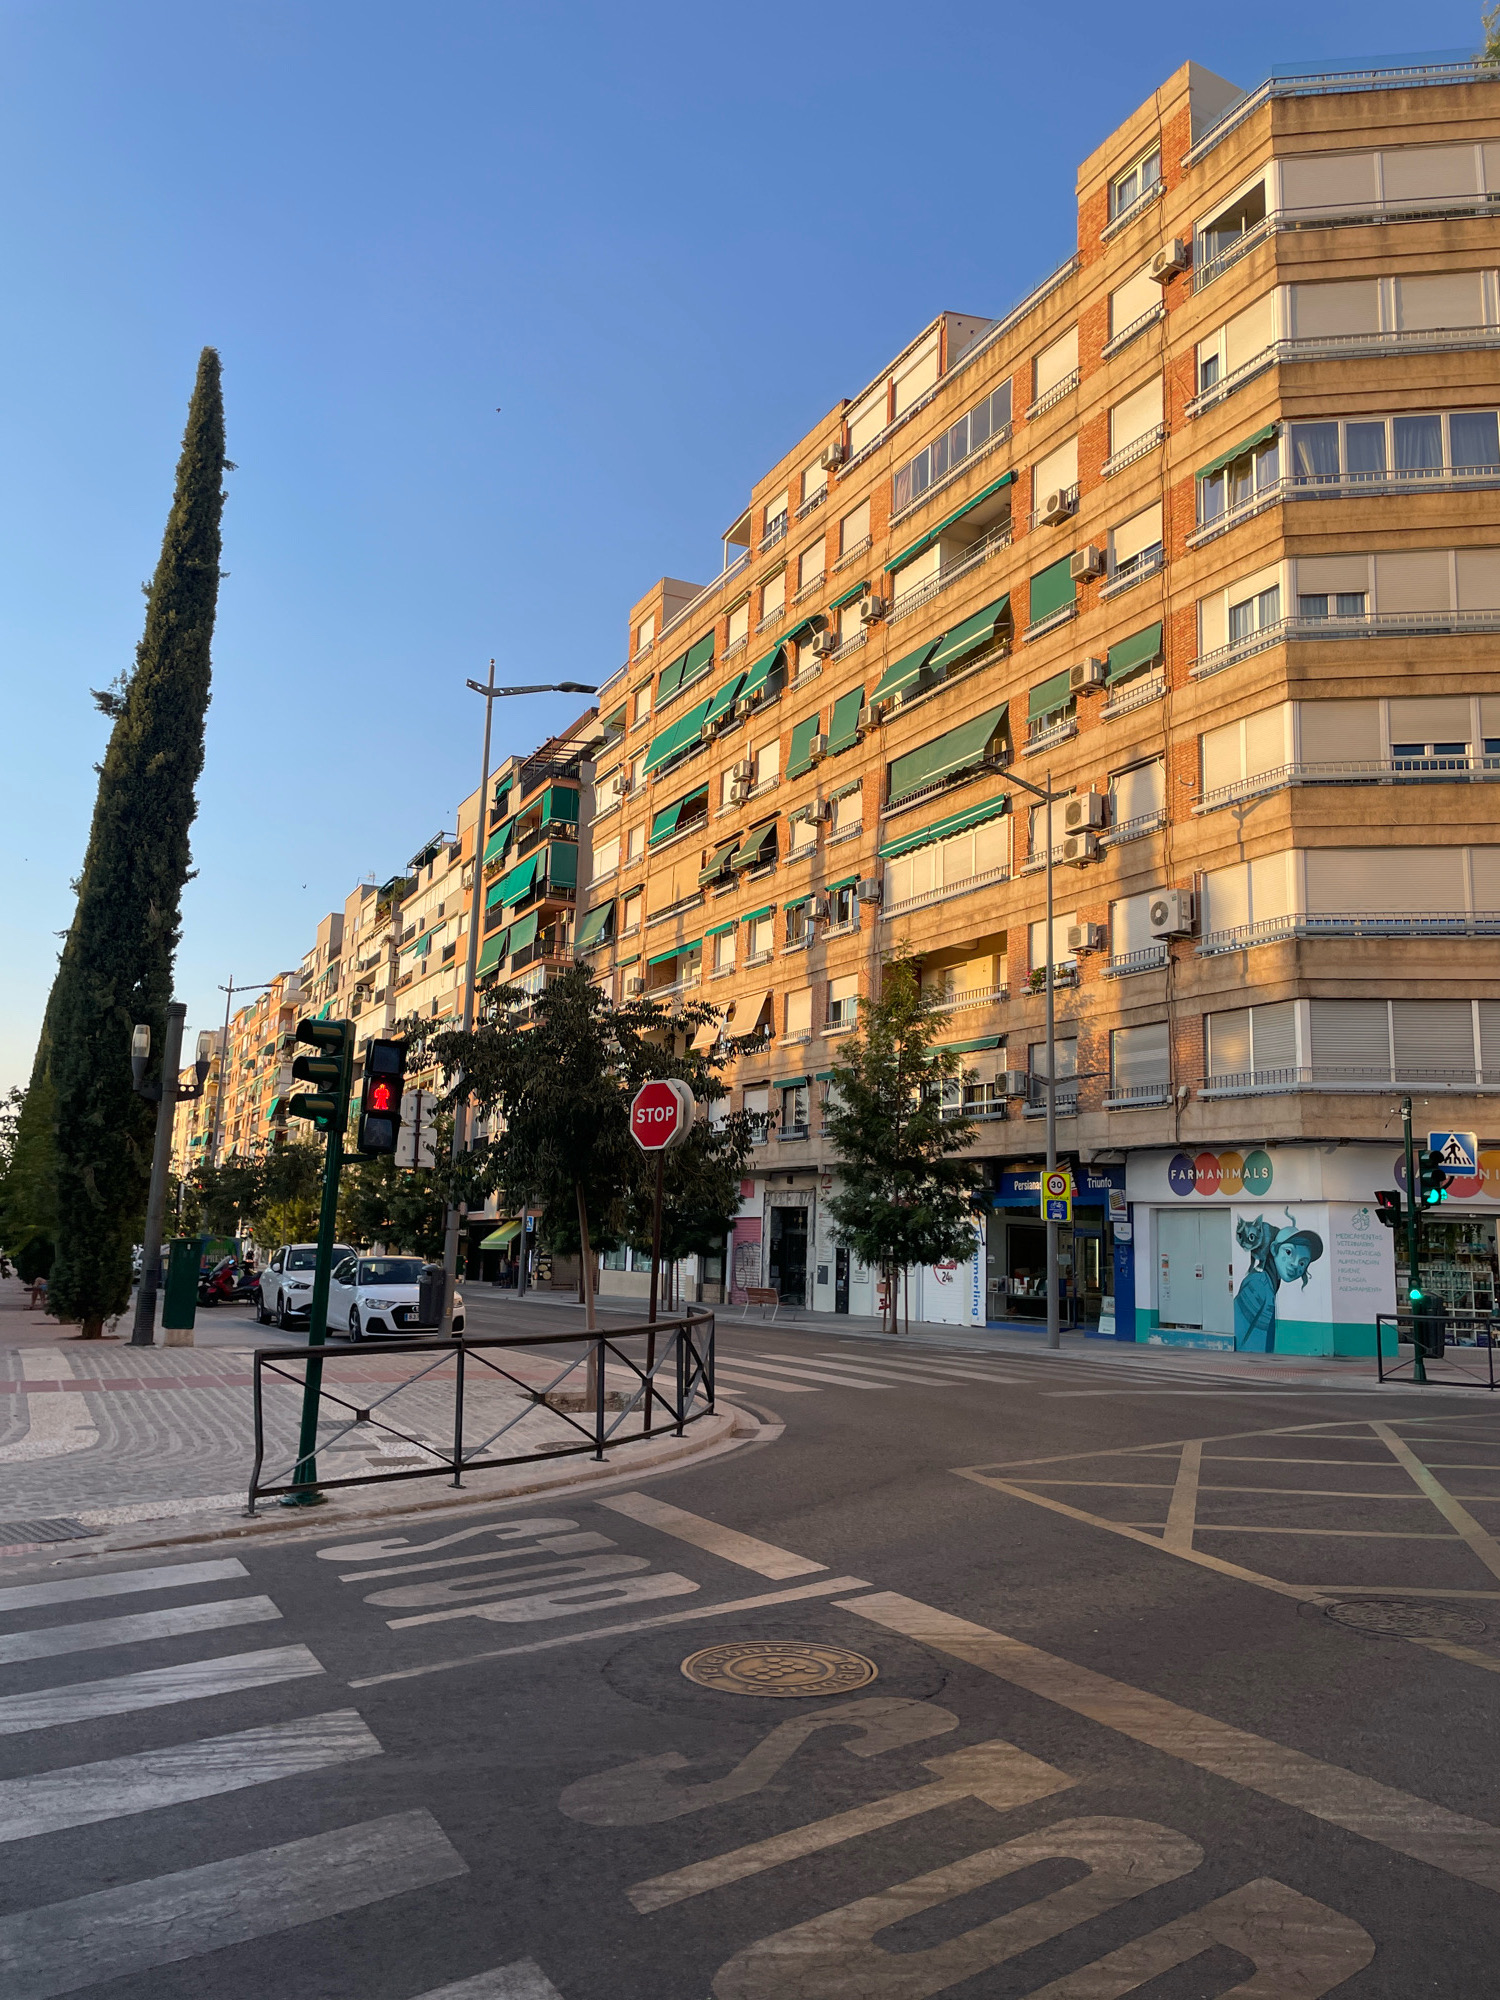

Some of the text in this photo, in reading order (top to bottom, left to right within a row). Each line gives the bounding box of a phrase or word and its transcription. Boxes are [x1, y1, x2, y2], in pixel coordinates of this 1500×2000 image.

[636, 1106, 674, 1123] STOP
[1171, 1167, 1269, 1180] FARMANIMALS
[1014, 1177, 1112, 1191] Persianas Triunfo
[1050, 1180, 1063, 1189] 30
[972, 1231, 981, 1316] Kmmerling
[315, 1517, 701, 1631] STOP
